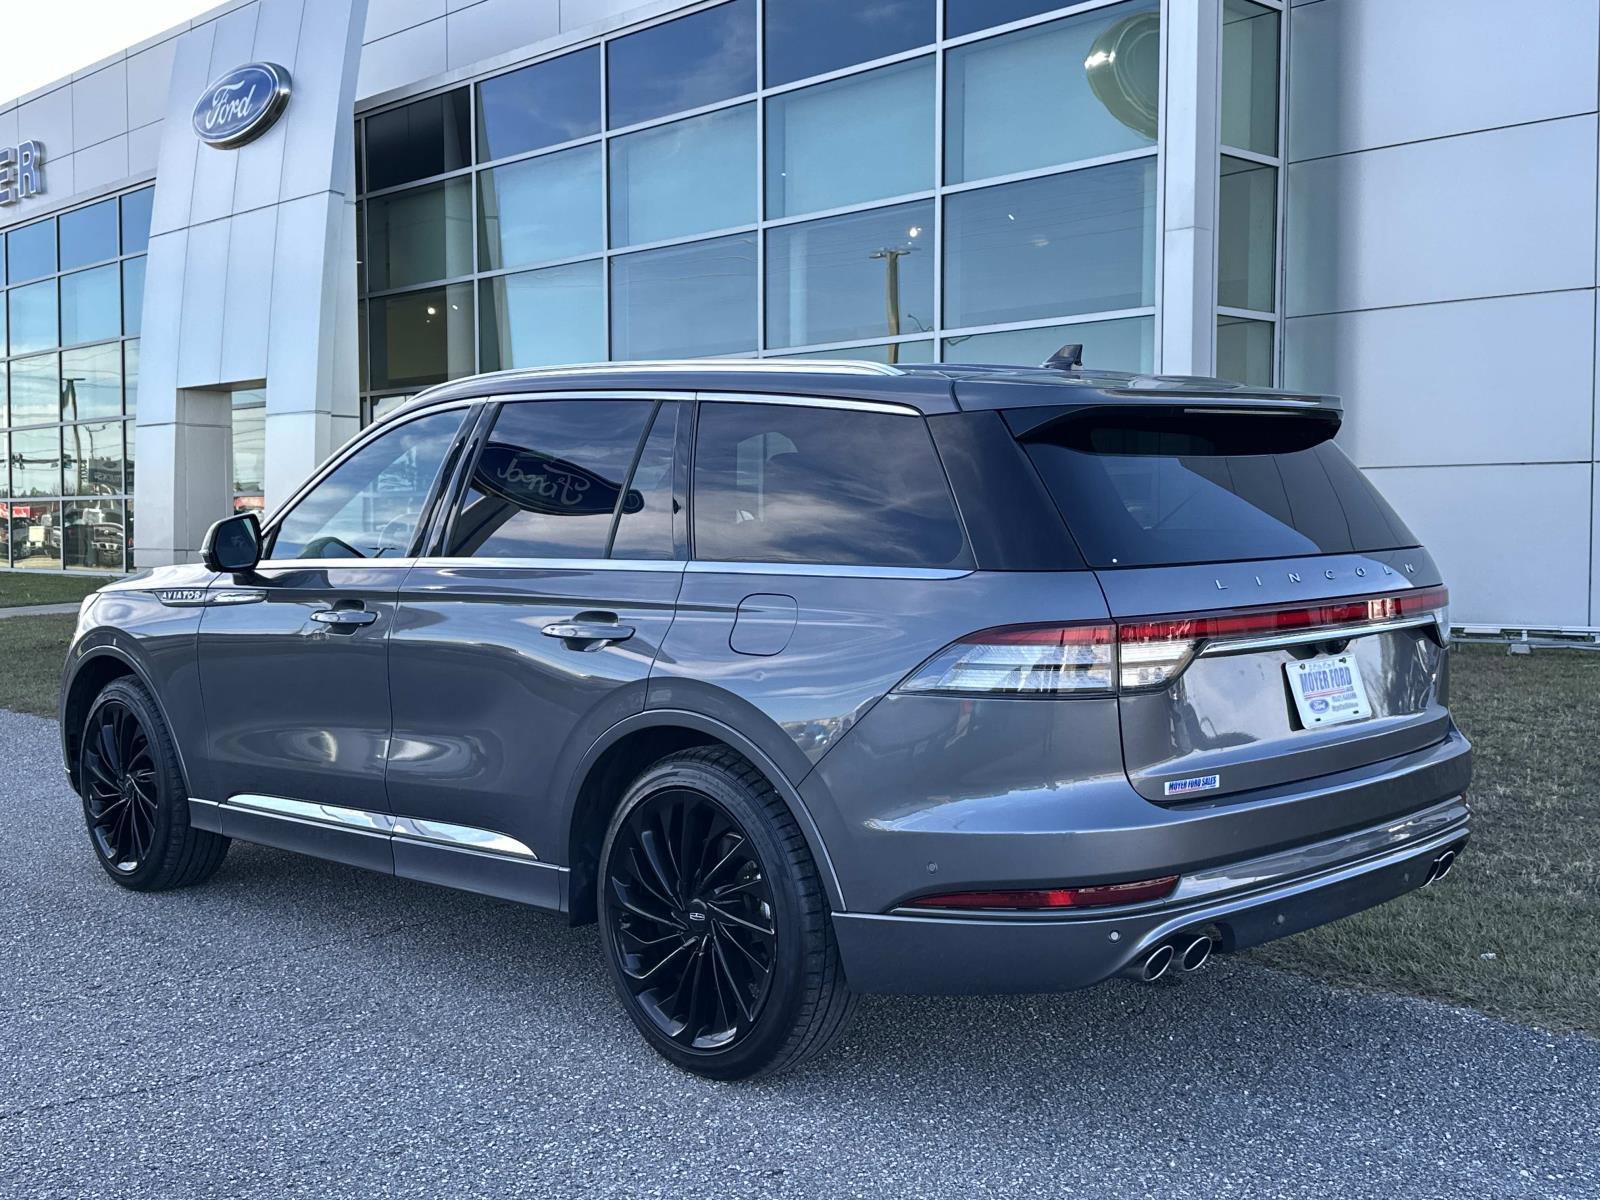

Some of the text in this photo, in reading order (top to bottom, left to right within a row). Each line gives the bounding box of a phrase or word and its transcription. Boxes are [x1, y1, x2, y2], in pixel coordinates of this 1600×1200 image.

[206, 80, 256, 129] Ford
[1215, 563, 1414, 590] LINCOLN
[162, 590, 201, 600] AVIATOR
[1300, 667, 1352, 692] MOYER FORD
